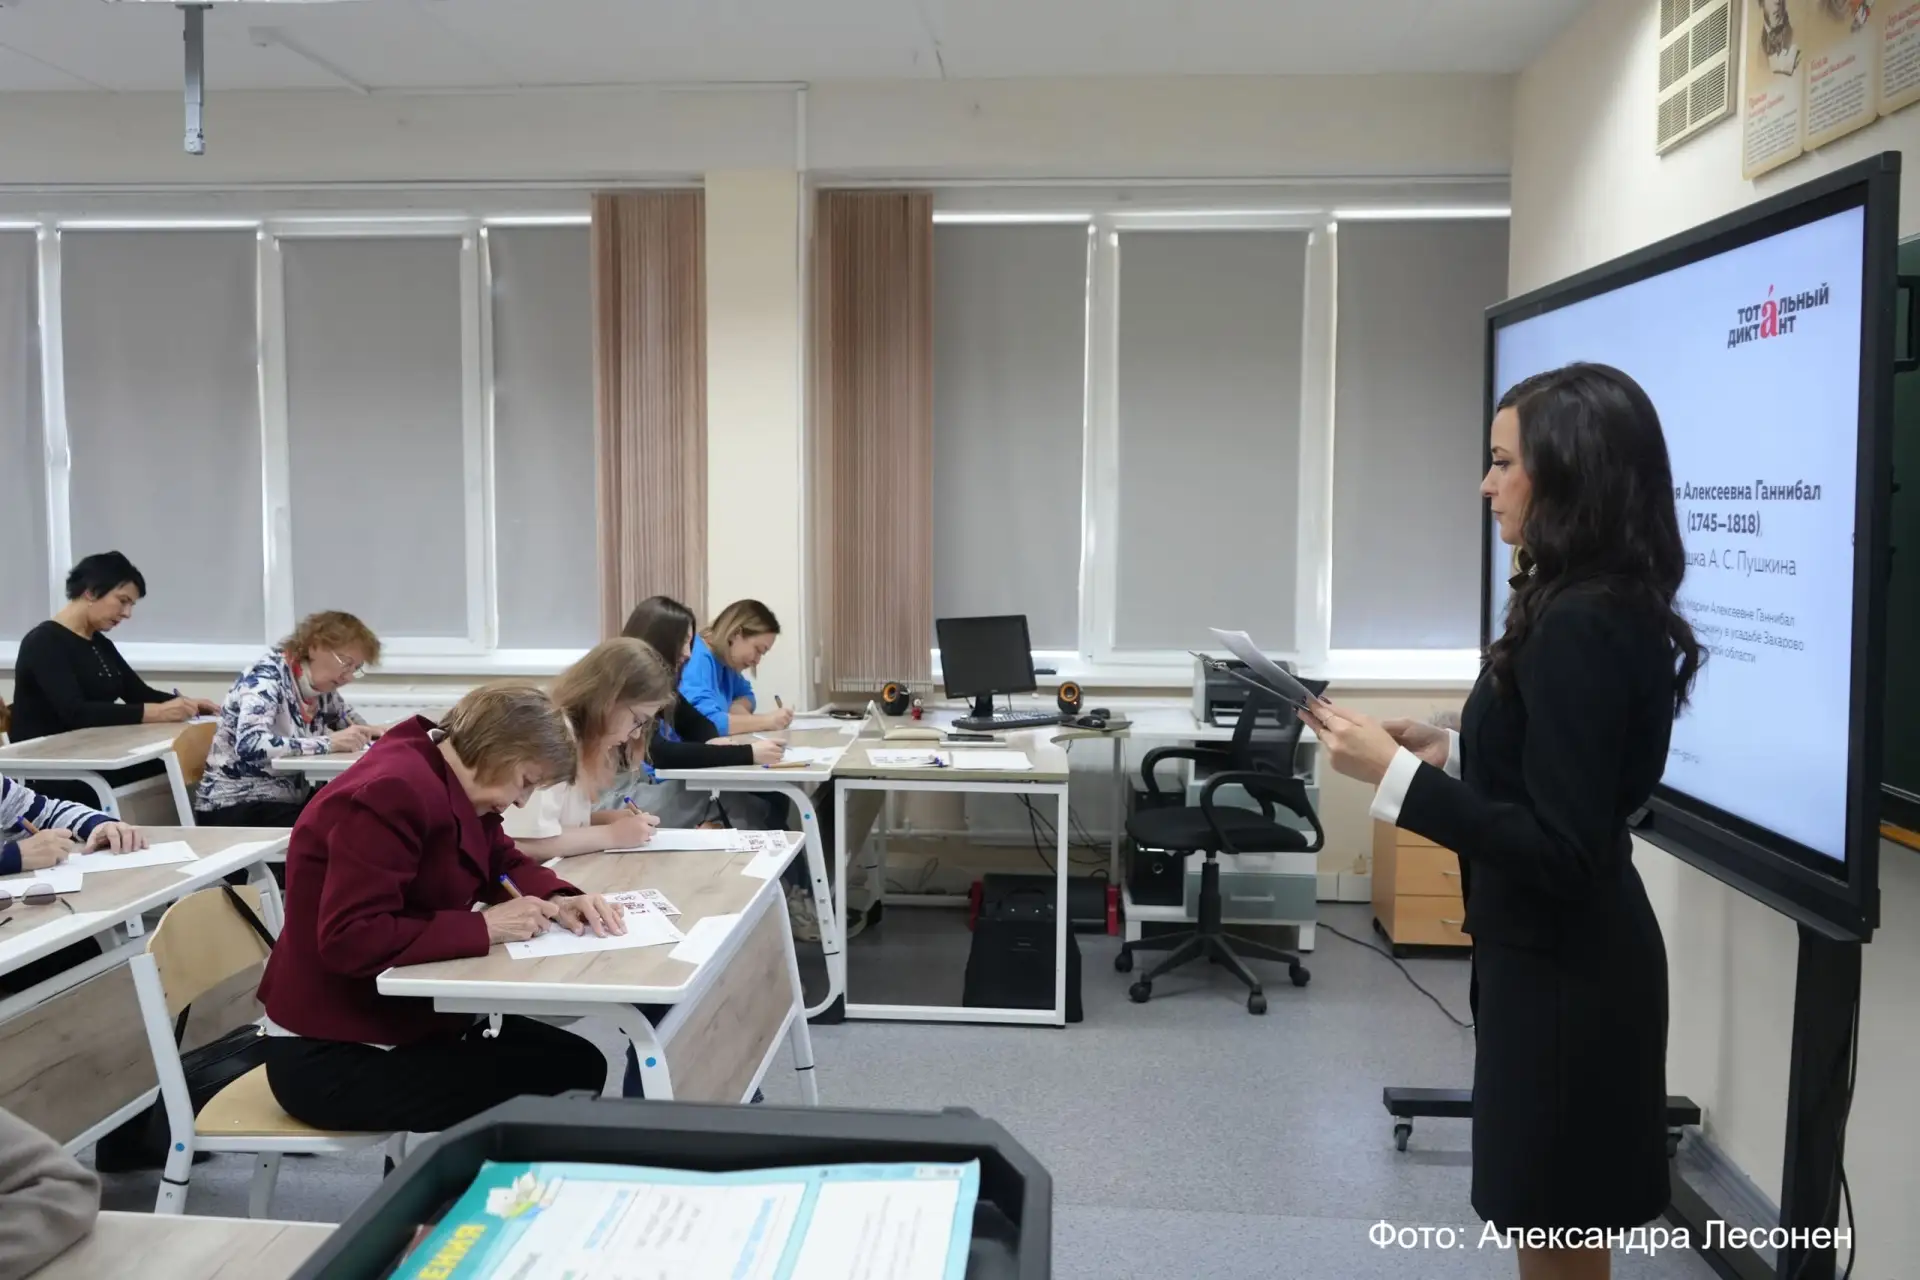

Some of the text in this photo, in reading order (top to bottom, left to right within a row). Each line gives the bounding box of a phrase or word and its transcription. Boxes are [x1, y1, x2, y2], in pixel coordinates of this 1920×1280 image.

[1683, 480, 1752, 500] Алексеевна
[1755, 479, 1821, 500] Ганнибал
[1737, 550, 1796, 577] Пушкина
[1710, 601, 1754, 620] Алексеевне
[1756, 607, 1795, 628] Ганнибал
[1763, 630, 1804, 652] Захарово
